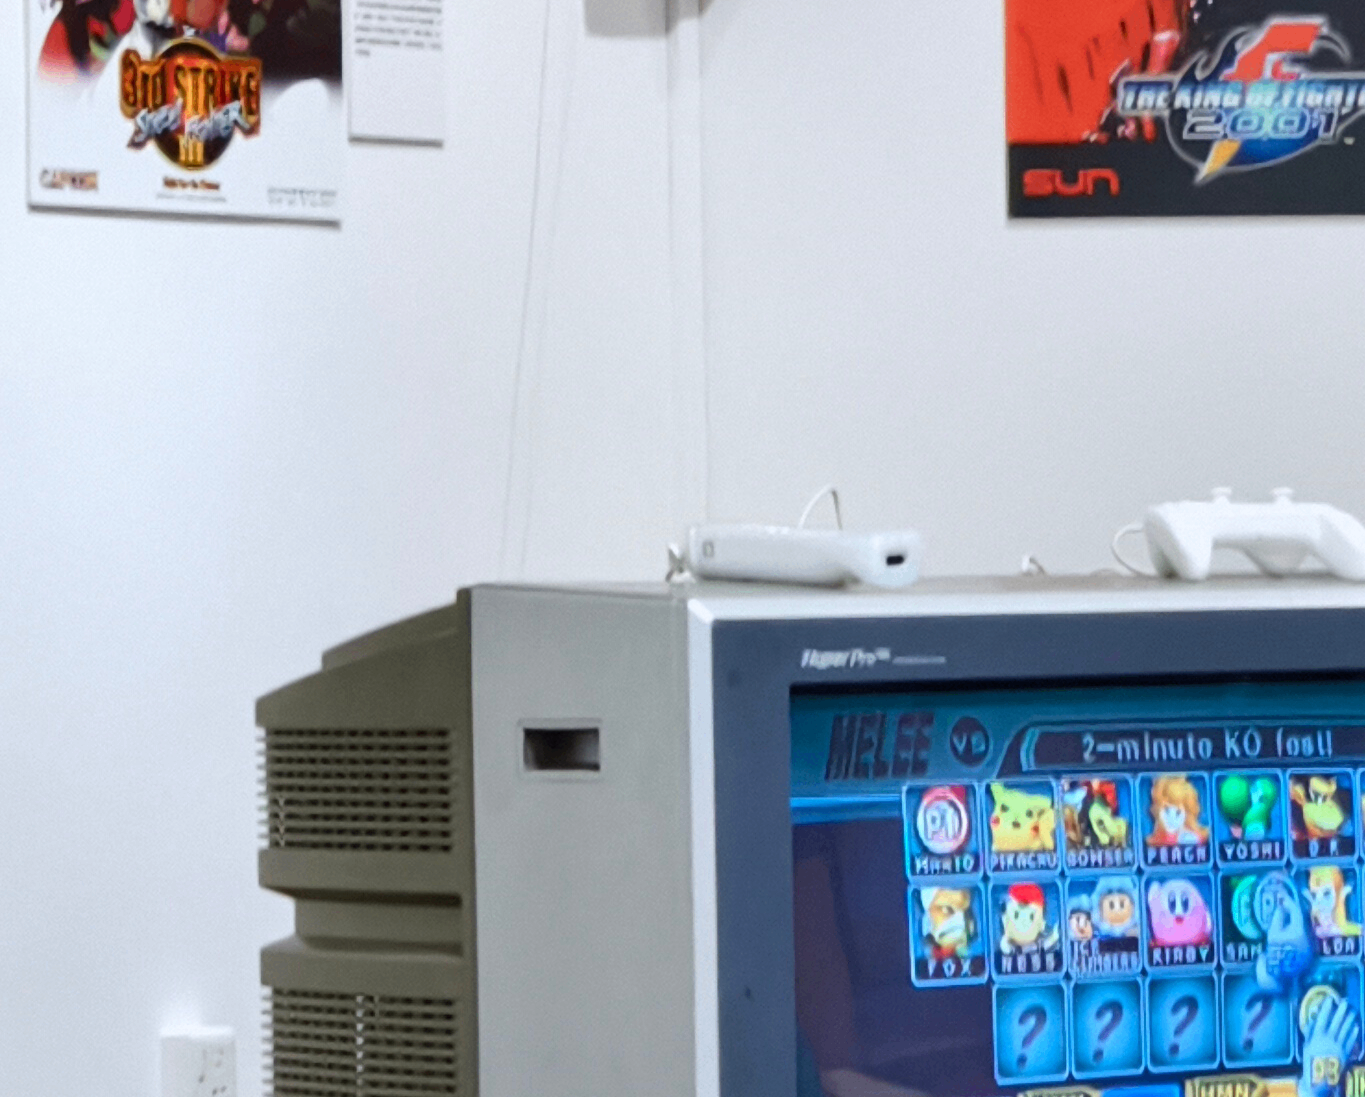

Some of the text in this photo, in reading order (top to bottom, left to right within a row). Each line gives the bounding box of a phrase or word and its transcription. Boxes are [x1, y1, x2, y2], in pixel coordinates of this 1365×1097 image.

[1183, 107, 1338, 140] 2001
[824, 711, 935, 781] MELEE
[1224, 727, 1262, 759] KO
[1223, 841, 1281, 860] YOSHI
[927, 957, 971, 978] FOX
